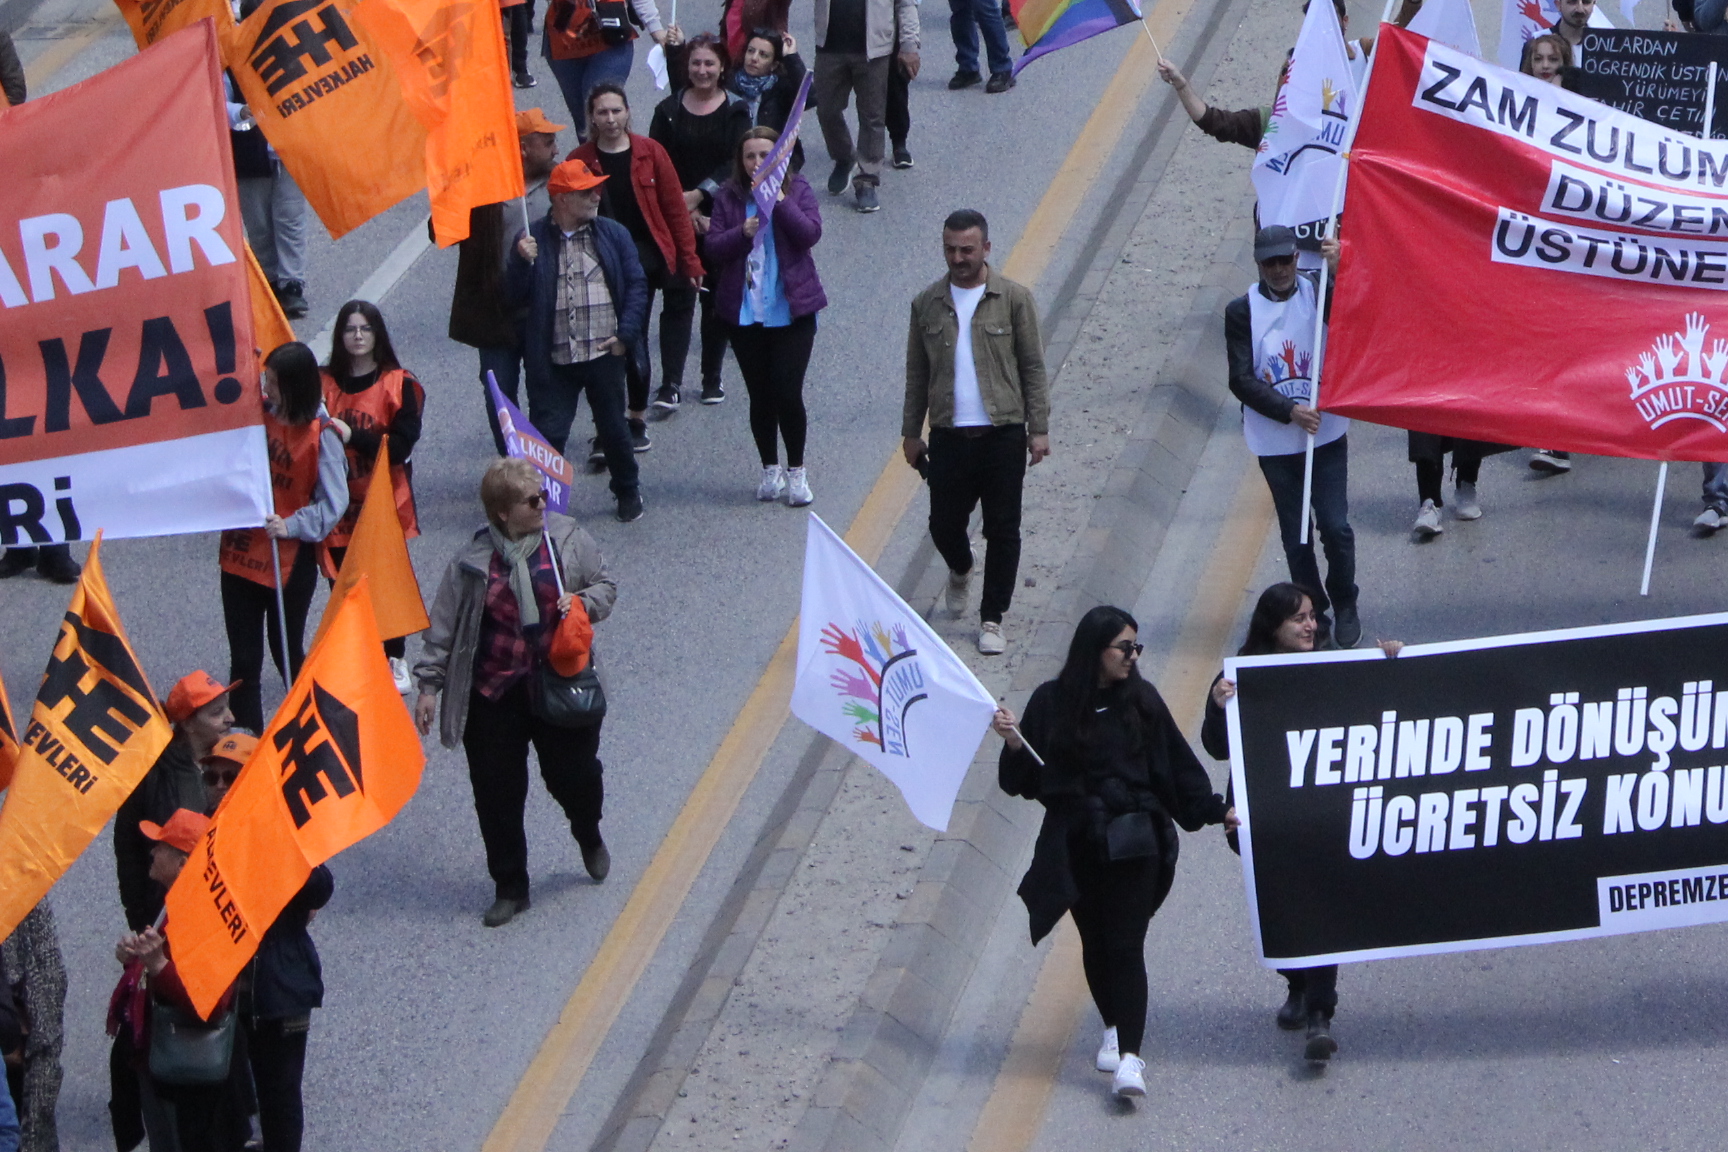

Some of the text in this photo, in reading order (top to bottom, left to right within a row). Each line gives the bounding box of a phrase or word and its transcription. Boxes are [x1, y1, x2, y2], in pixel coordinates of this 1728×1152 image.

[1583, 33, 1678, 56] ONLARDAN
[1419, 61, 1541, 142] ZAM
[1495, 209, 1727, 285] ÜSTÜNE
[1285, 708, 1495, 789] YERİNDE
[1347, 774, 1584, 861] ÜCRETSİZ
